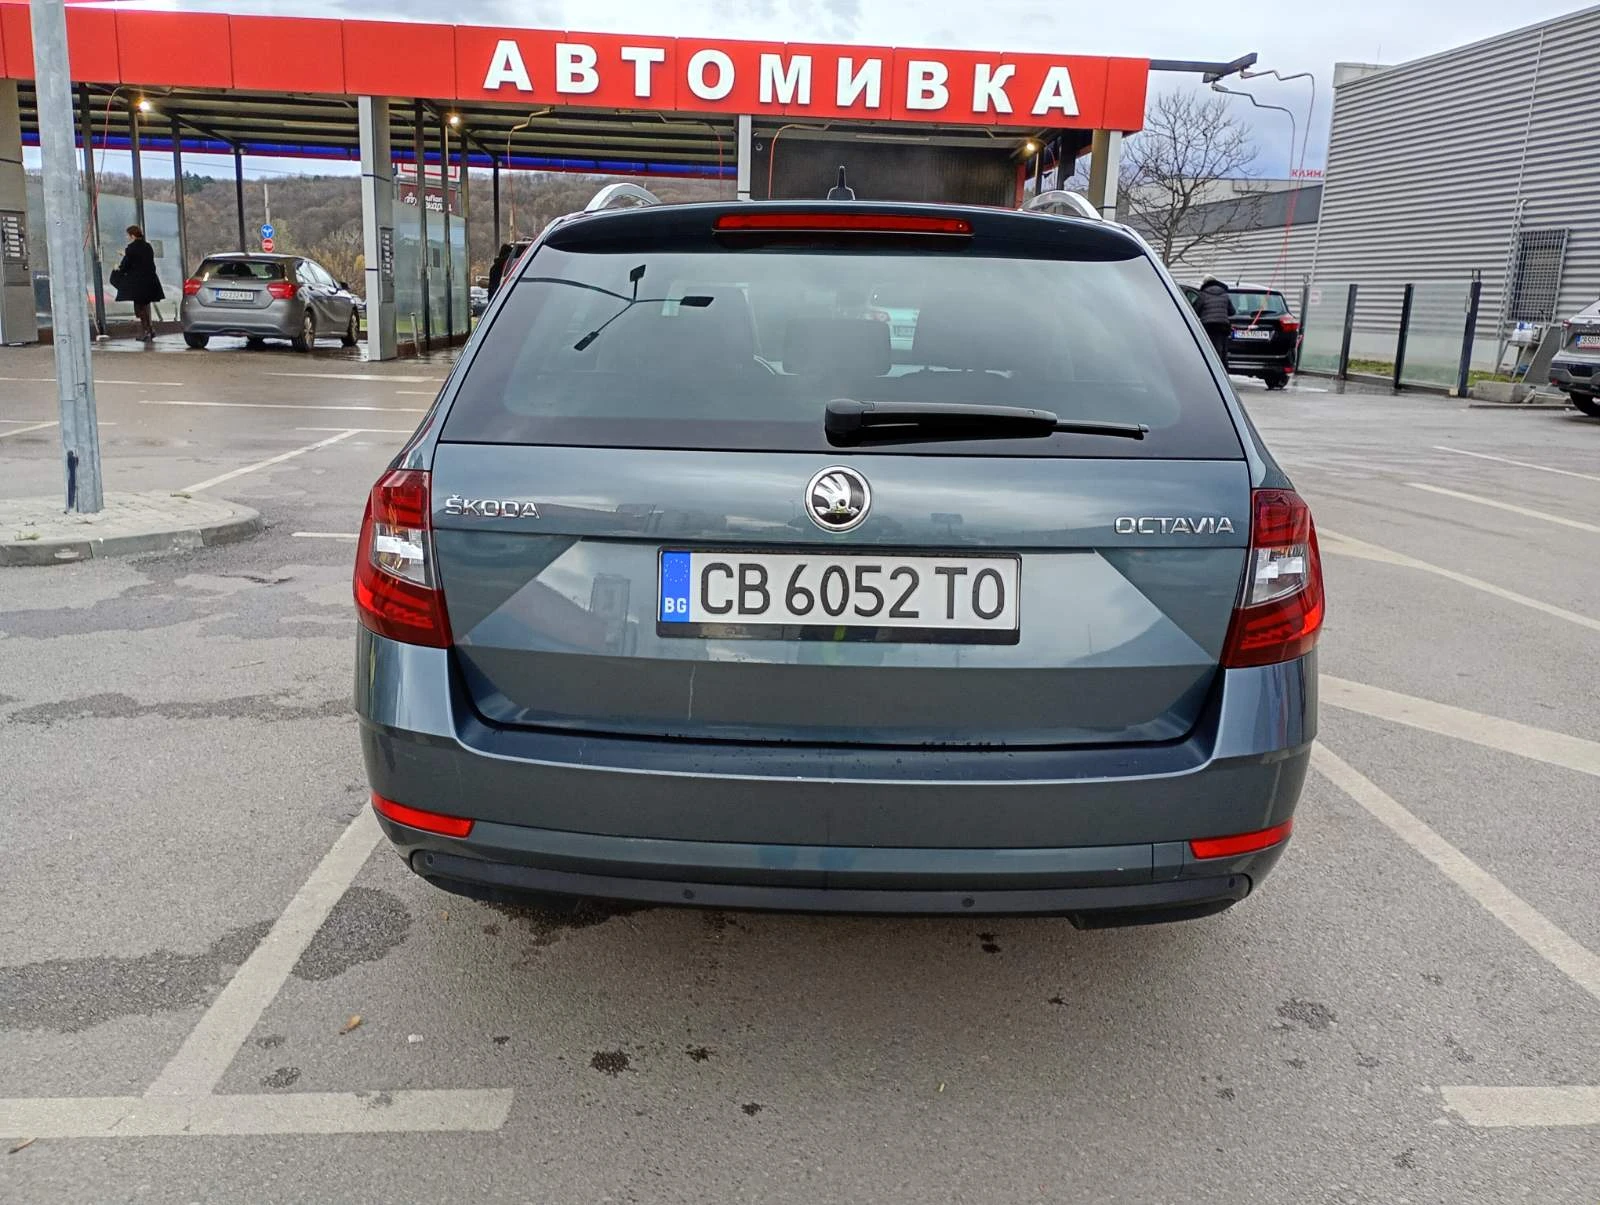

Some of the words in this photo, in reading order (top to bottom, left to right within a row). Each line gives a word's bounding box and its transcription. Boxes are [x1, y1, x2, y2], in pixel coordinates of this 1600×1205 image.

[482, 38, 1080, 117] АВТОМИВКА
[445, 494, 540, 519] ŠKODA
[1115, 516, 1236, 534] OCTAVIA
[700, 562, 771, 615] CB
[785, 563, 920, 619] 6052
[934, 566, 1005, 620] TO
[664, 597, 687, 614] BG
